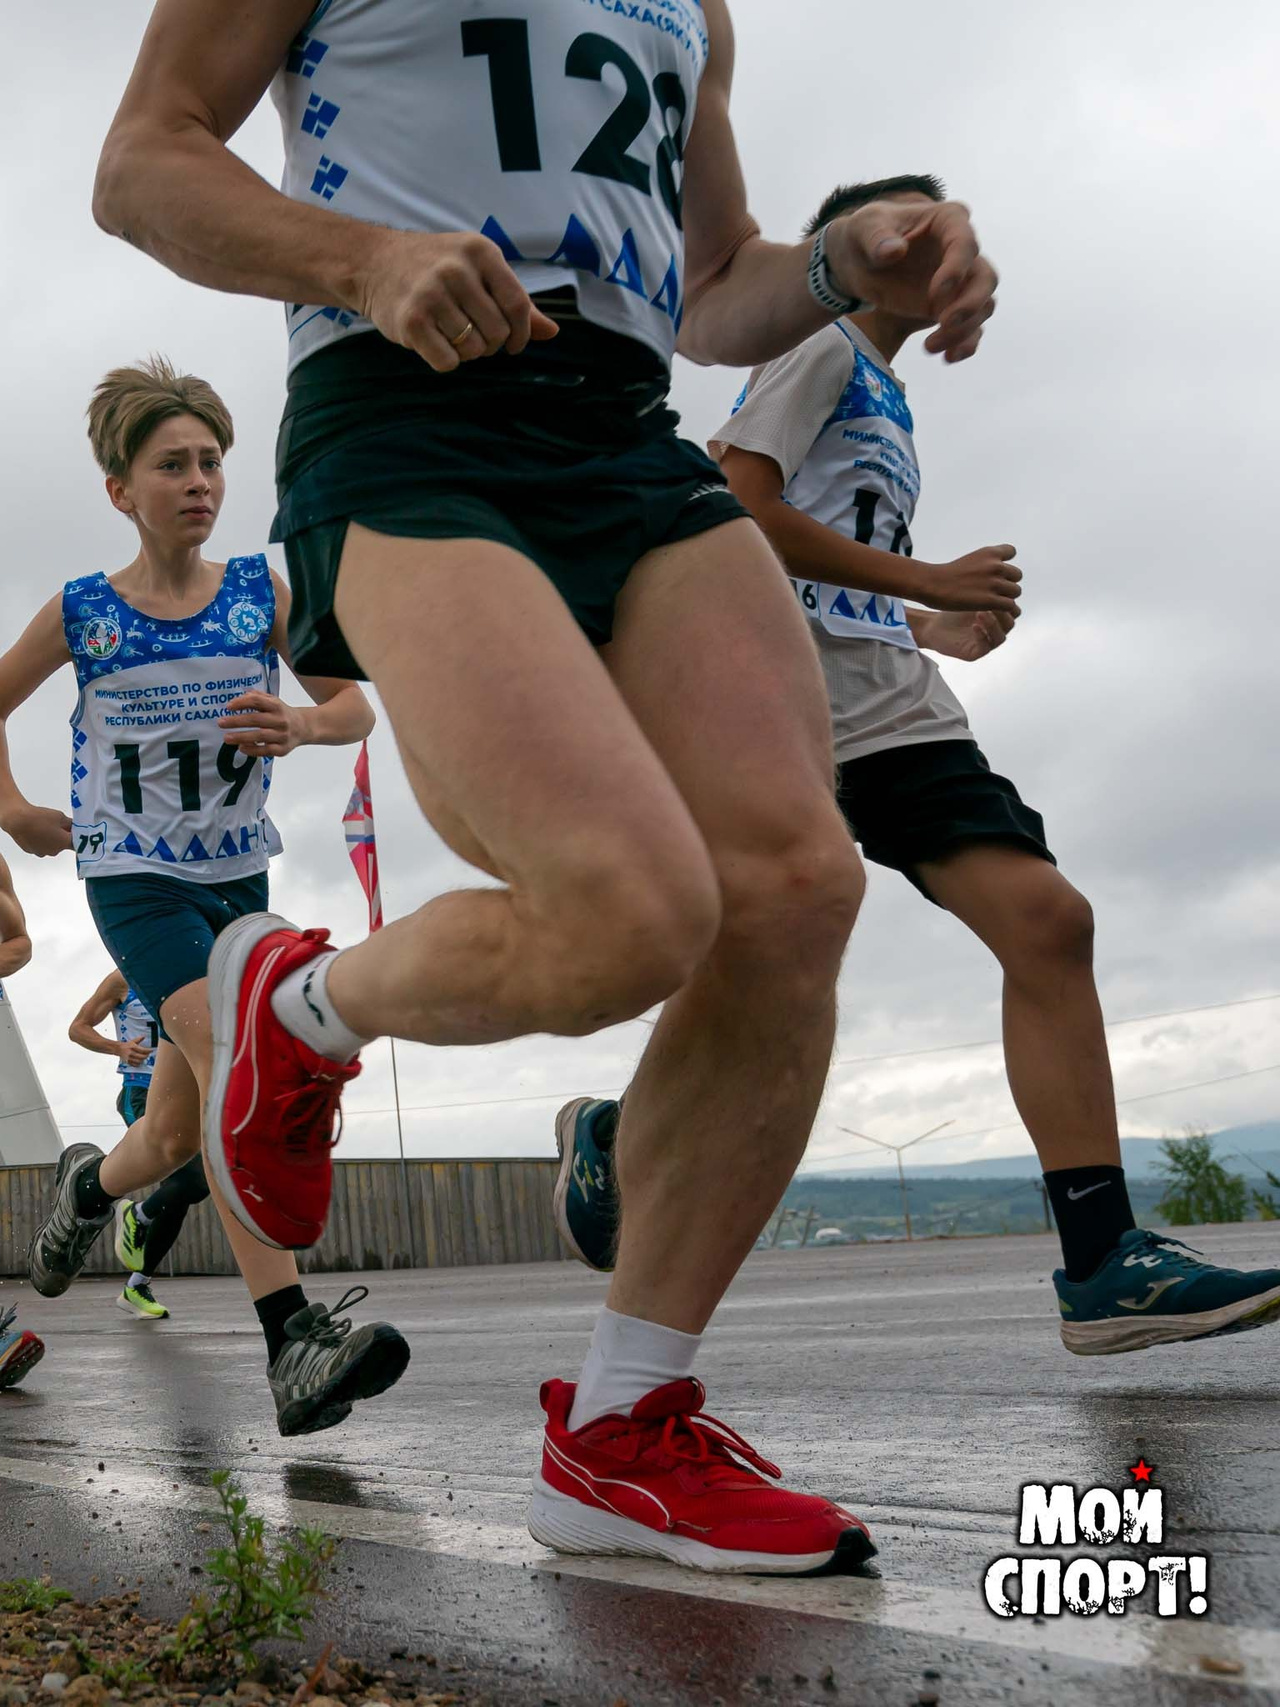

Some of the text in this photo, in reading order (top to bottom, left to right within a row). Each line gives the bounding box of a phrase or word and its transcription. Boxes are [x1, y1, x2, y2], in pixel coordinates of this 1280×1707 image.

[461, 18, 686, 230] 128
[95, 684, 179, 700] МИНИСТЕРСТВО
[182, 682, 201, 695] ПО
[122, 698, 185, 714] КУЛЬТУРЕ
[189, 697, 198, 707] И
[105, 712, 181, 727] РЕСПУБЛИКИ
[114, 739, 258, 814] 119
